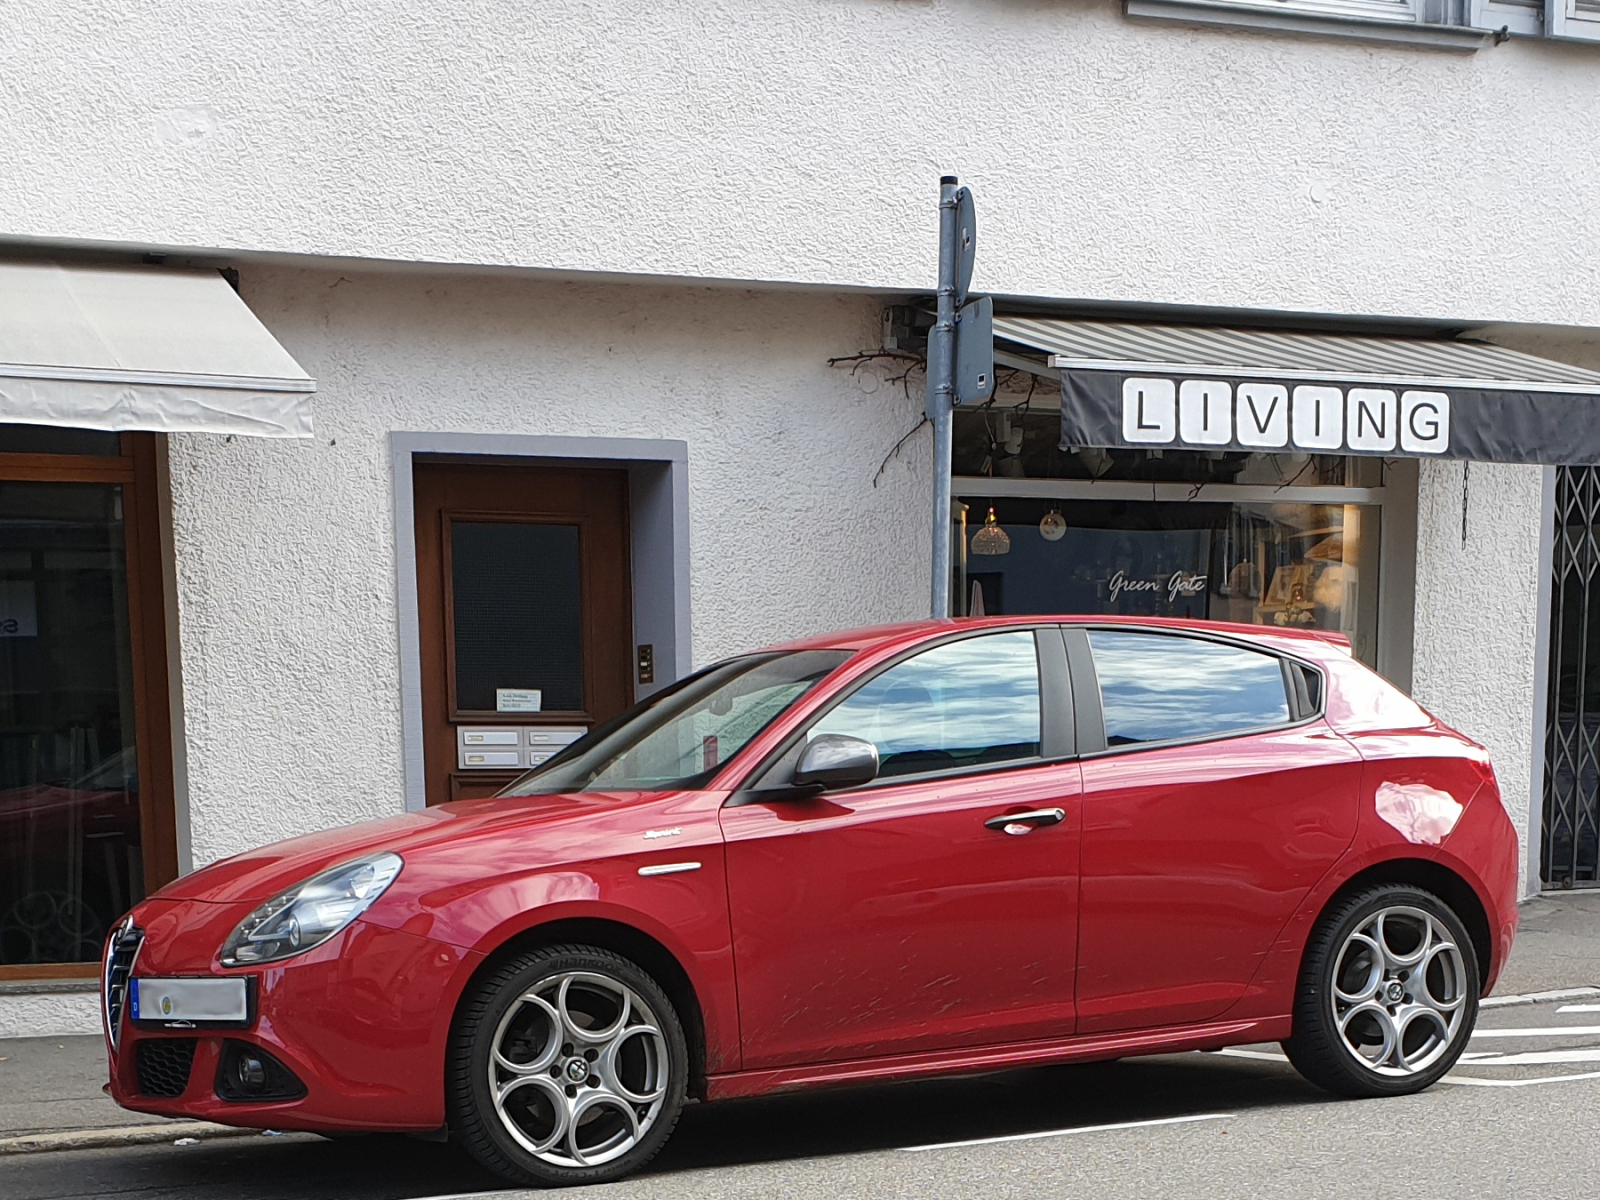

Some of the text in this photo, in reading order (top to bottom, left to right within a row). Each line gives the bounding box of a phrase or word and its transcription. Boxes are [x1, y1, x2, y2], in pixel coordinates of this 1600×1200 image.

[1136, 390, 1440, 441] LIVING
[1108, 570, 1208, 602] Green Gate
